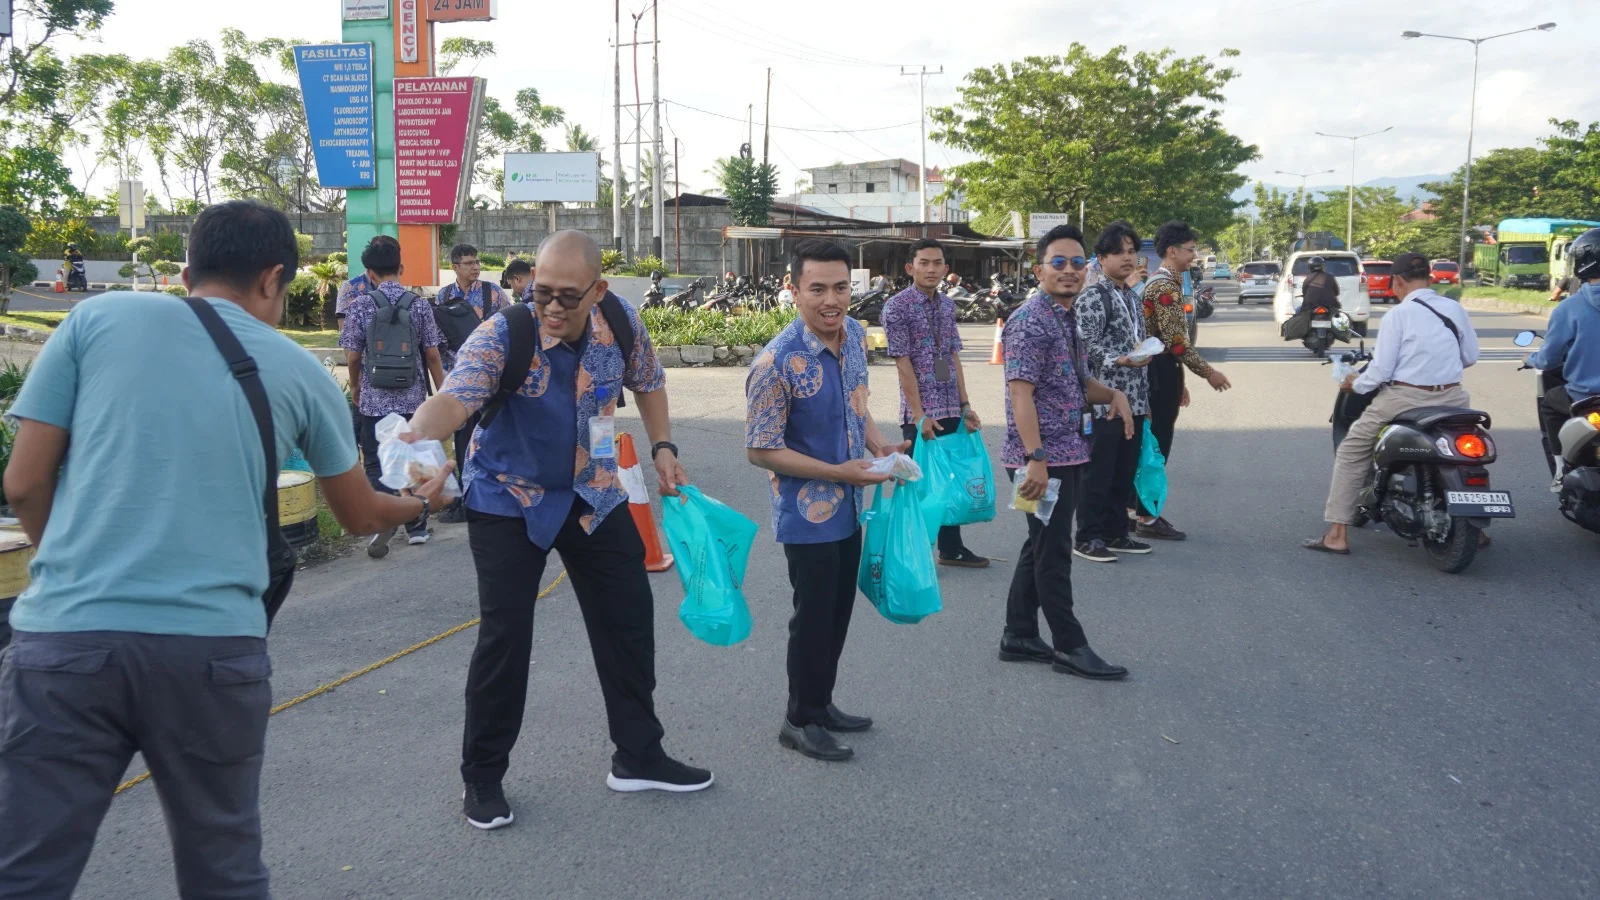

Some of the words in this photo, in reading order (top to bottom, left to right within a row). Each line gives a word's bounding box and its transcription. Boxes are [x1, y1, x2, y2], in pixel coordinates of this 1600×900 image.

[433, 0, 450, 11] 24
[454, 0, 484, 10] JAM
[402, 0, 414, 57] GENCY
[301, 47, 367, 59] FASILITAS
[352, 63, 368, 71] TESLA
[322, 74, 329, 82] CT
[330, 74, 343, 82] SCAN
[351, 74, 368, 82] SLICES
[397, 81, 467, 92] PELAYANAN
[349, 95, 359, 104] USG
[360, 95, 364, 103] 4
[425, 97, 431, 105] 24
[432, 97, 442, 105] JAM
[333, 106, 368, 115] FLUOROSCOPY
[398, 108, 434, 116] LABORATORIUM
[441, 107, 452, 115] JAM
[399, 139, 419, 147] MEDICAL
[420, 139, 433, 147] CHEK
[433, 138, 441, 146] UP
[399, 149, 415, 157] RAWAT
[415, 149, 427, 157] INAP
[352, 160, 356, 168] C
[359, 160, 371, 168] ARM
[416, 159, 427, 167] INAP
[428, 159, 443, 167] KELAS
[399, 169, 415, 177] RAWAT
[416, 169, 427, 177] INAP
[428, 169, 442, 177] ANAK
[430, 208, 435, 216] &
[435, 208, 449, 216] ANAK
[1450, 494, 1463, 502] BA
[1464, 494, 1488, 502] 6256
